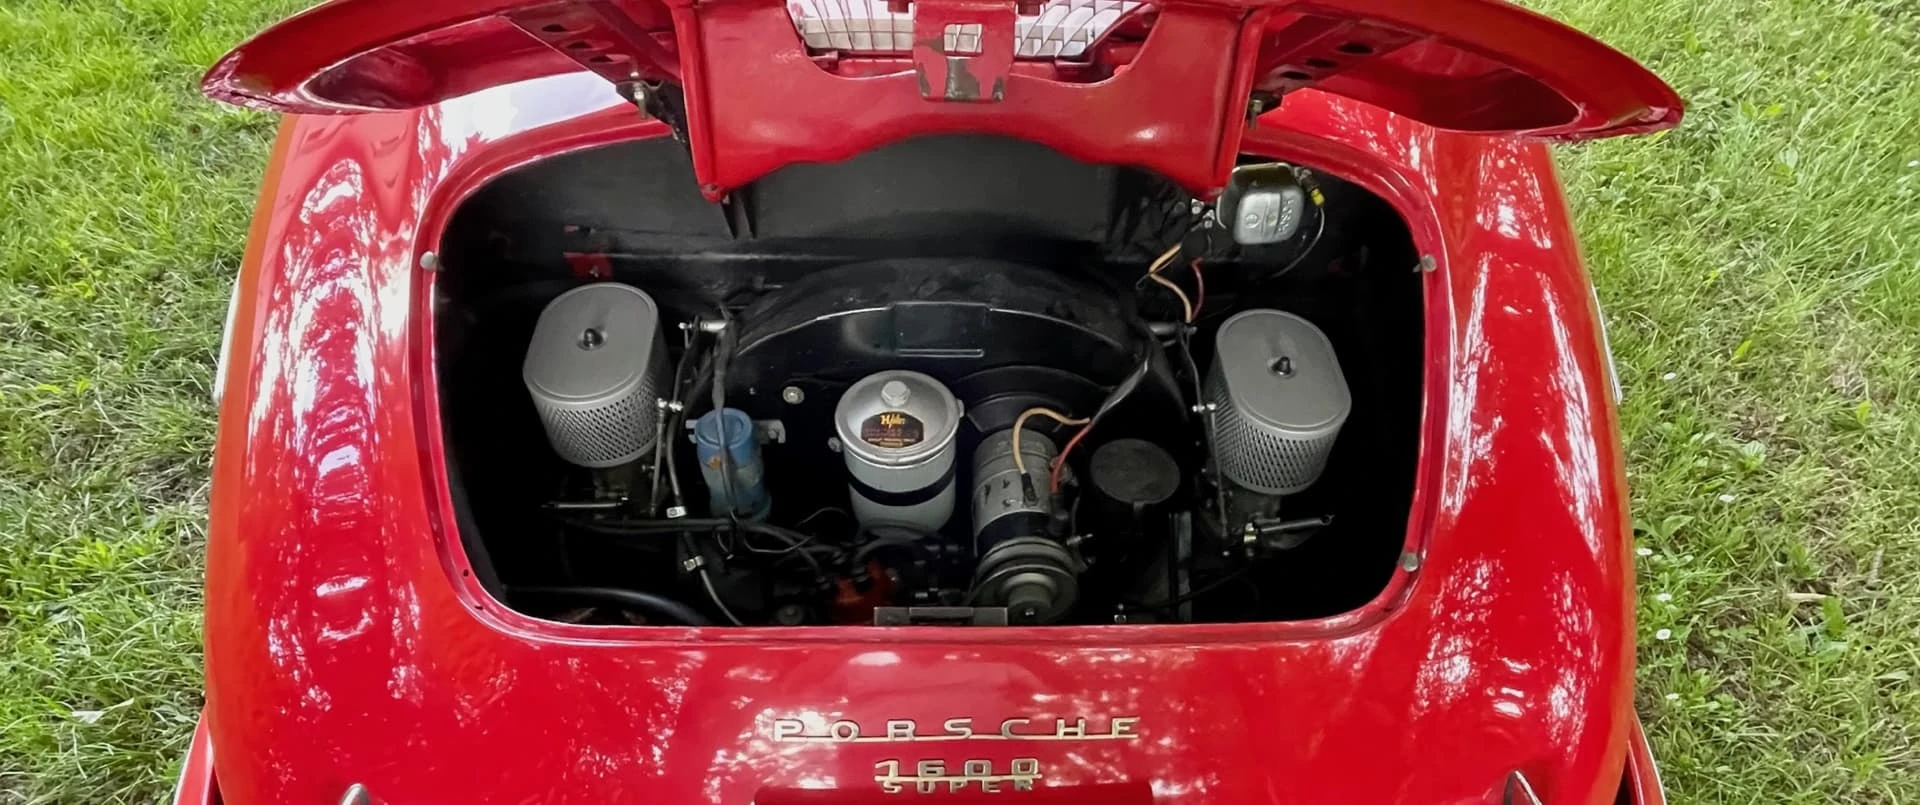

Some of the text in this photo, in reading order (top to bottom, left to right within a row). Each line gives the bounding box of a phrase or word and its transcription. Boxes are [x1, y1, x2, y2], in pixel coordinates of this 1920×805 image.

[773, 717, 1140, 742] PORSCHE
[874, 758, 1041, 780] 1600
[881, 778, 1034, 793] SUPER
